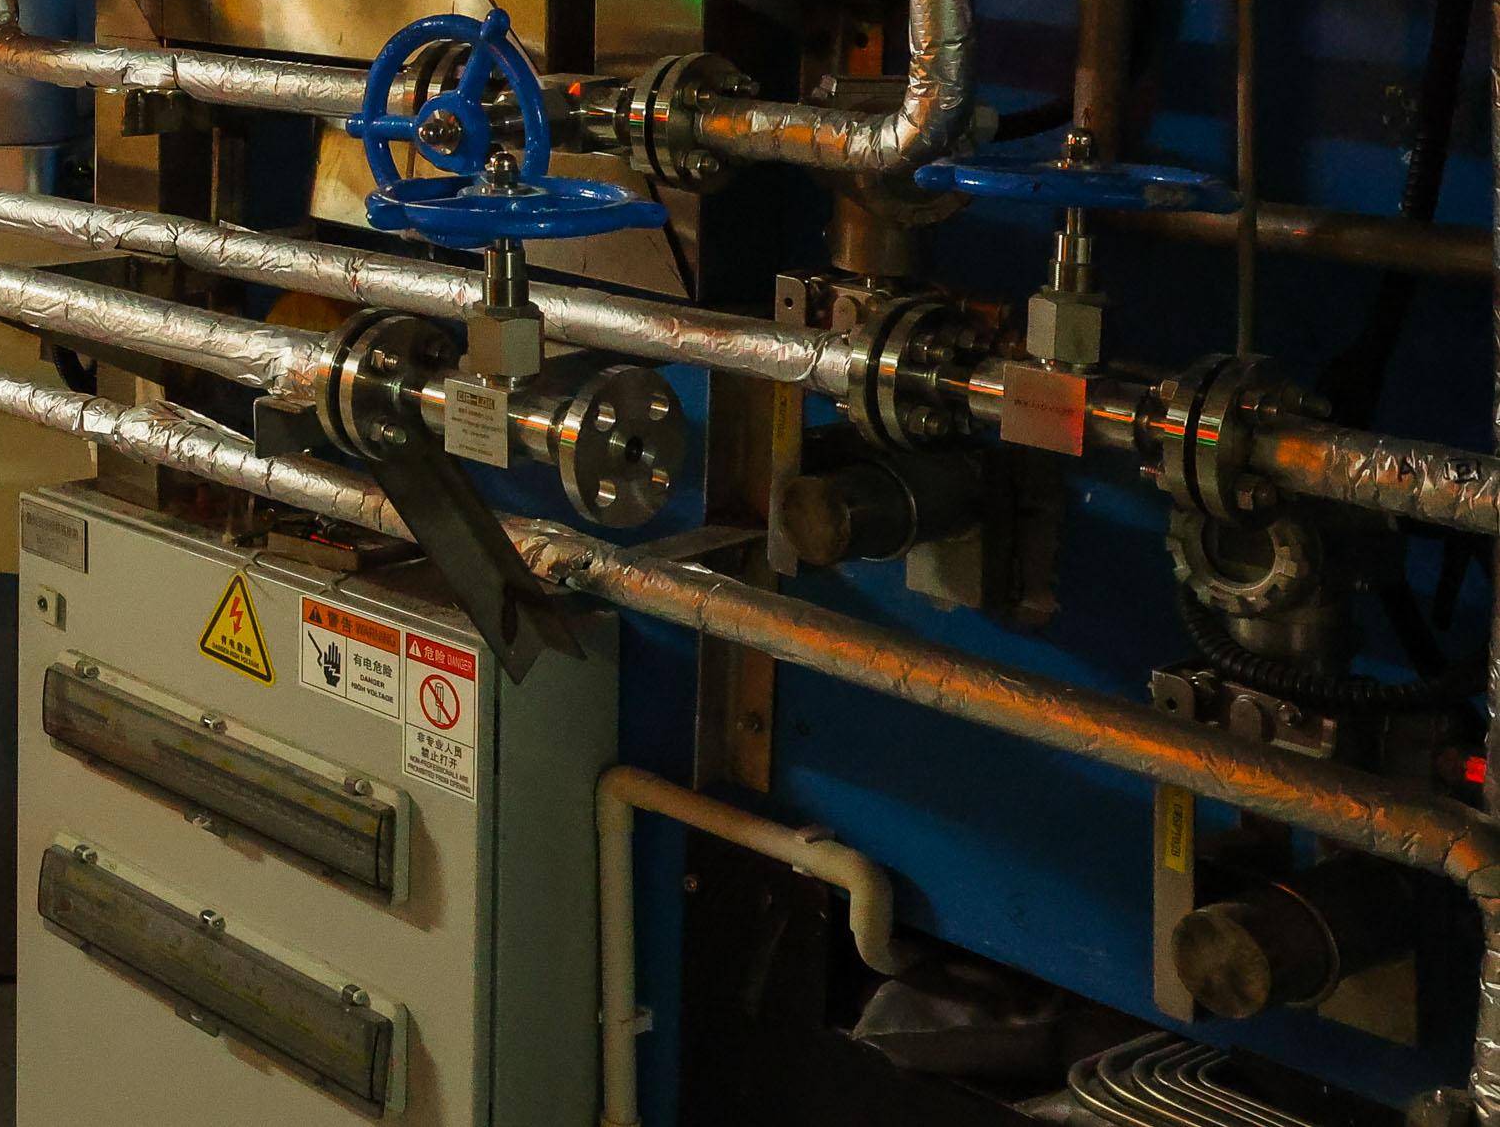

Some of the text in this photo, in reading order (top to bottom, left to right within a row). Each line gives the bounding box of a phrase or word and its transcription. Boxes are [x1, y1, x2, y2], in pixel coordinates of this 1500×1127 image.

[352, 653, 393, 678] 有电危险
[423, 645, 473, 673] 危险 DANGER
[351, 681, 394, 704] HIGH VOLTAGE
[360, 674, 385, 689] DANGER
[417, 732, 462, 759] 非专业人员
[421, 746, 457, 769] 禁止打开
